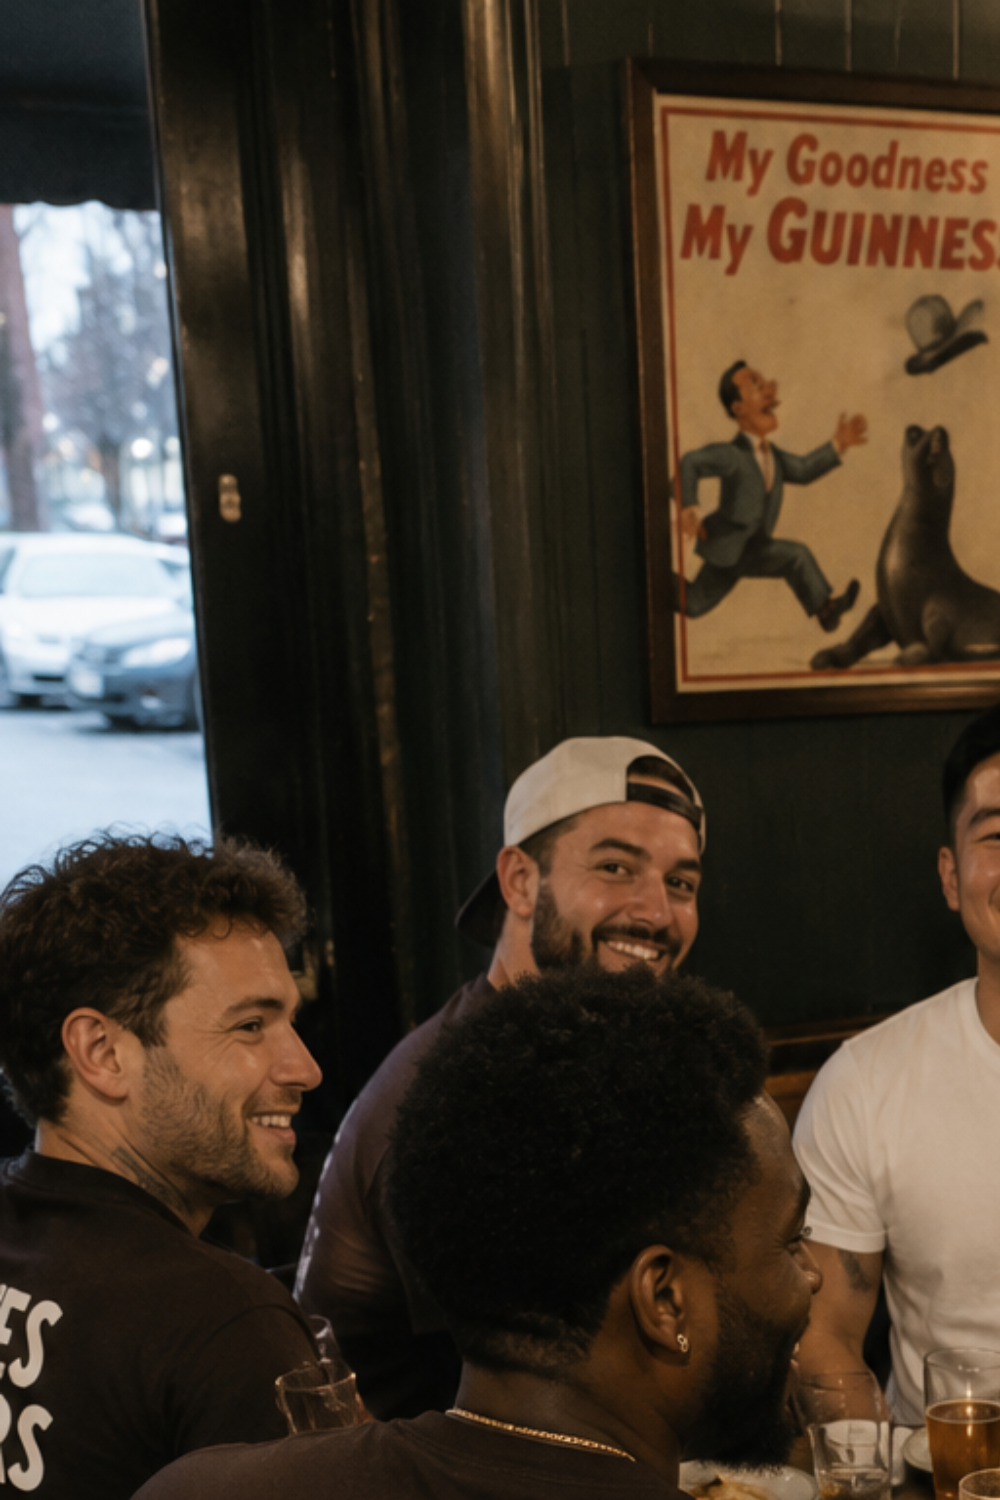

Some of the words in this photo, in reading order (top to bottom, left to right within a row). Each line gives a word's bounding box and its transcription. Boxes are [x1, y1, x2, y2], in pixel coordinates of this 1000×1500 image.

[706, 129, 775, 197] My
[786, 132, 989, 194] Goodness
[680, 203, 754, 276] My
[0, 1283, 64, 1389] ES
